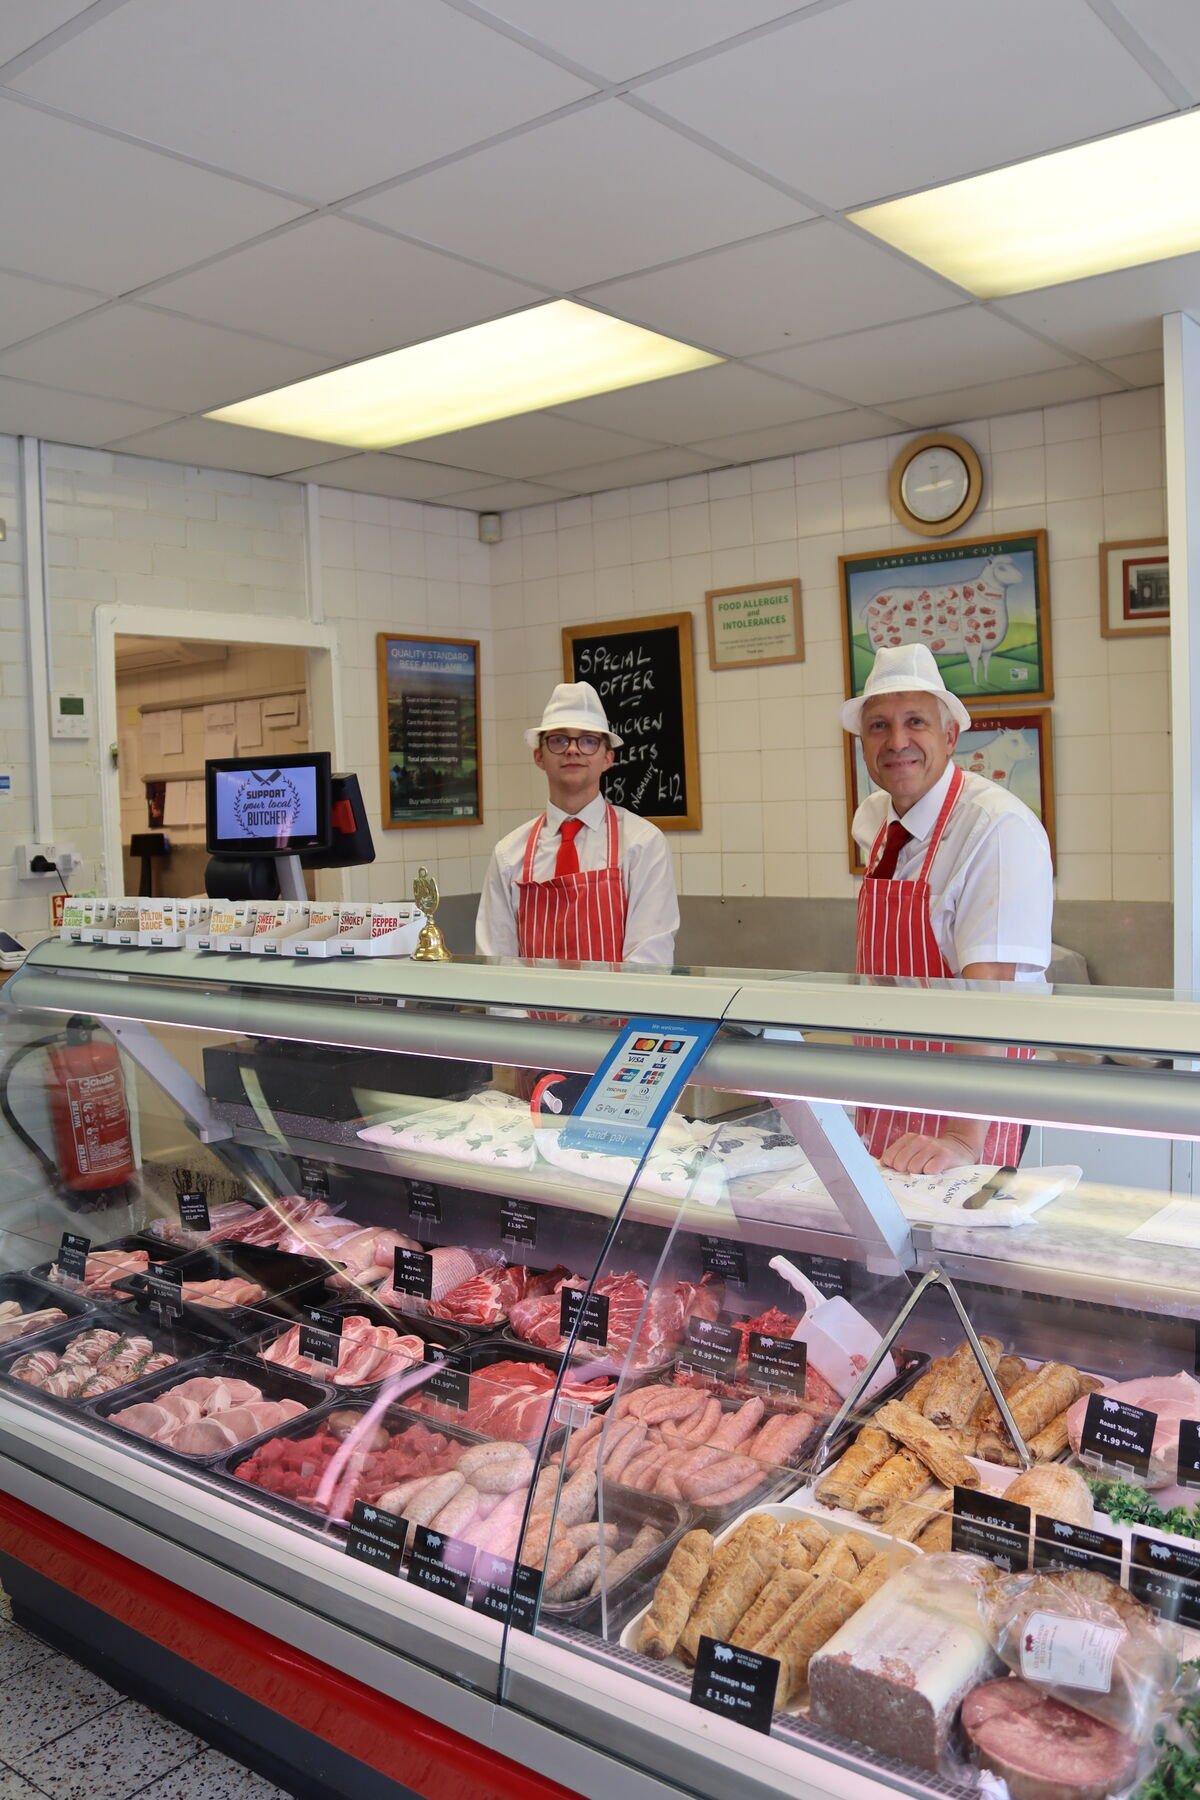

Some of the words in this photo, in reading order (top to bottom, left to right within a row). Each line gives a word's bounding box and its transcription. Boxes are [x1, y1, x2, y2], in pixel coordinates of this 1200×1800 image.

[974, 546, 1003, 554] CUTS
[718, 601, 742, 611] FOOD
[744, 595, 789, 608] ALLERGIES
[748, 608, 760, 616] and
[722, 615, 786, 630] INTOLERANCES
[392, 648, 426, 658] QUALITY
[428, 650, 469, 662] STANDARD
[579, 646, 652, 674] SPECIAL
[600, 670, 655, 696] OFFER
[608, 712, 662, 735] HICKEN
[246, 789, 286, 799] SUPPORT
[658, 770, 682, 803] £12
[242, 801, 265, 813] your
[268, 798, 292, 809] local
[247, 810, 287, 826] BUTCHER
[140, 912, 163, 921] STILTON
[257, 915, 276, 924] SWEET
[340, 916, 364, 926] SMOKEY
[372, 917, 398, 928] PEPPER
[140, 921, 163, 930] SAUCE
[71, 1100, 82, 1128] WATER
[604, 1104, 618, 1114] Pay
[78, 1144, 88, 1172] WATER
[700, 1338, 711, 1347] Pork
[712, 1342, 732, 1353] Sausage
[698, 1350, 712, 1360] 8.99
[752, 1352, 764, 1360] Thick
[766, 1355, 777, 1363] Pork
[778, 1358, 800, 1367] Sausage
[764, 1366, 779, 1376] 8.99
[1099, 1419, 1116, 1430] Roast
[1117, 1425, 1138, 1437] Turkey
[1096, 1432, 1101, 1440] £
[1102, 1434, 1121, 1446] 1.99
[1131, 1443, 1145, 1453] 100g
[351, 1525, 379, 1541] Lincolnshire
[379, 1535, 400, 1550] Sausage
[960, 1524, 984, 1538] Tongue
[986, 1532, 995, 1541] Ox
[996, 1536, 1022, 1549] Cooked
[356, 1542, 361, 1550] £
[362, 1544, 376, 1556] 8.99
[385, 1552, 390, 1560] kg
[1064, 1547, 1088, 1560] Haslet
[413, 1551, 429, 1563] Sweet
[431, 1557, 444, 1569] Chilli
[444, 1563, 466, 1578] Sausage
[419, 1569, 424, 1577] £
[425, 1571, 440, 1584] 8.99
[450, 1580, 456, 1588] kg
[477, 1577, 490, 1588] Pork
[497, 1584, 509, 1596] Leek
[513, 1592, 536, 1605] ausage
[1146, 1583, 1153, 1591] £
[1156, 1586, 1179, 1600] 2.19
[484, 1597, 489, 1605] £
[491, 1599, 508, 1612] 8.99
[710, 1671, 740, 1688] Sausage
[741, 1682, 756, 1693] Roll
[706, 1688, 712, 1697] £
[714, 1691, 735, 1706] 1.50
[737, 1698, 752, 1708] Each
